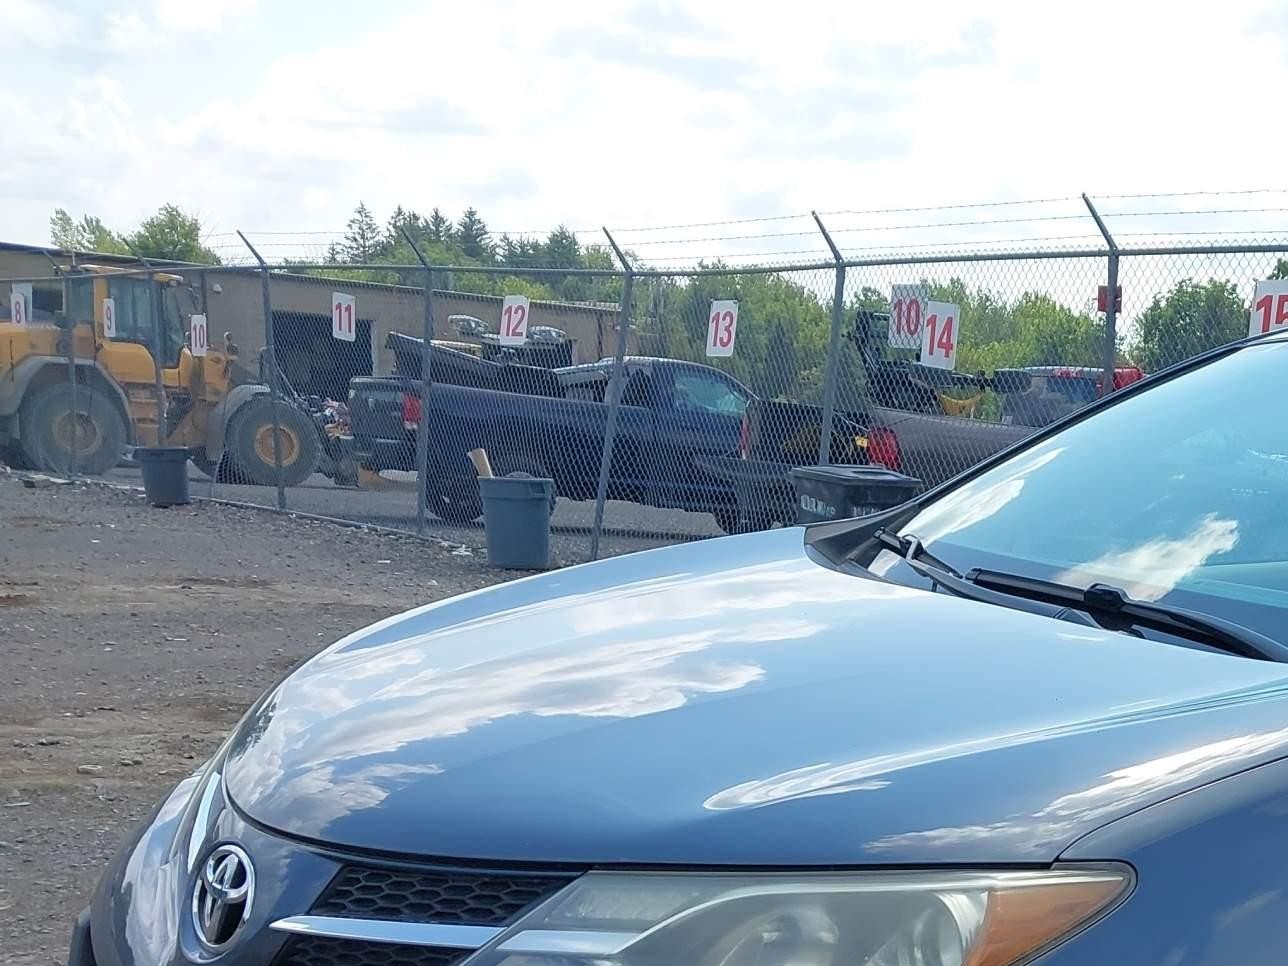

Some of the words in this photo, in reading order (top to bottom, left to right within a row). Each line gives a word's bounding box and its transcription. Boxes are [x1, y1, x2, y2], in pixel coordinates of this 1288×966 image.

[14, 300, 22, 324] 8
[335, 301, 353, 334] 11
[503, 304, 527, 337] 12
[893, 298, 921, 337] 10
[192, 325, 206, 348] 10
[711, 310, 735, 348] 13
[926, 314, 954, 358] 14
